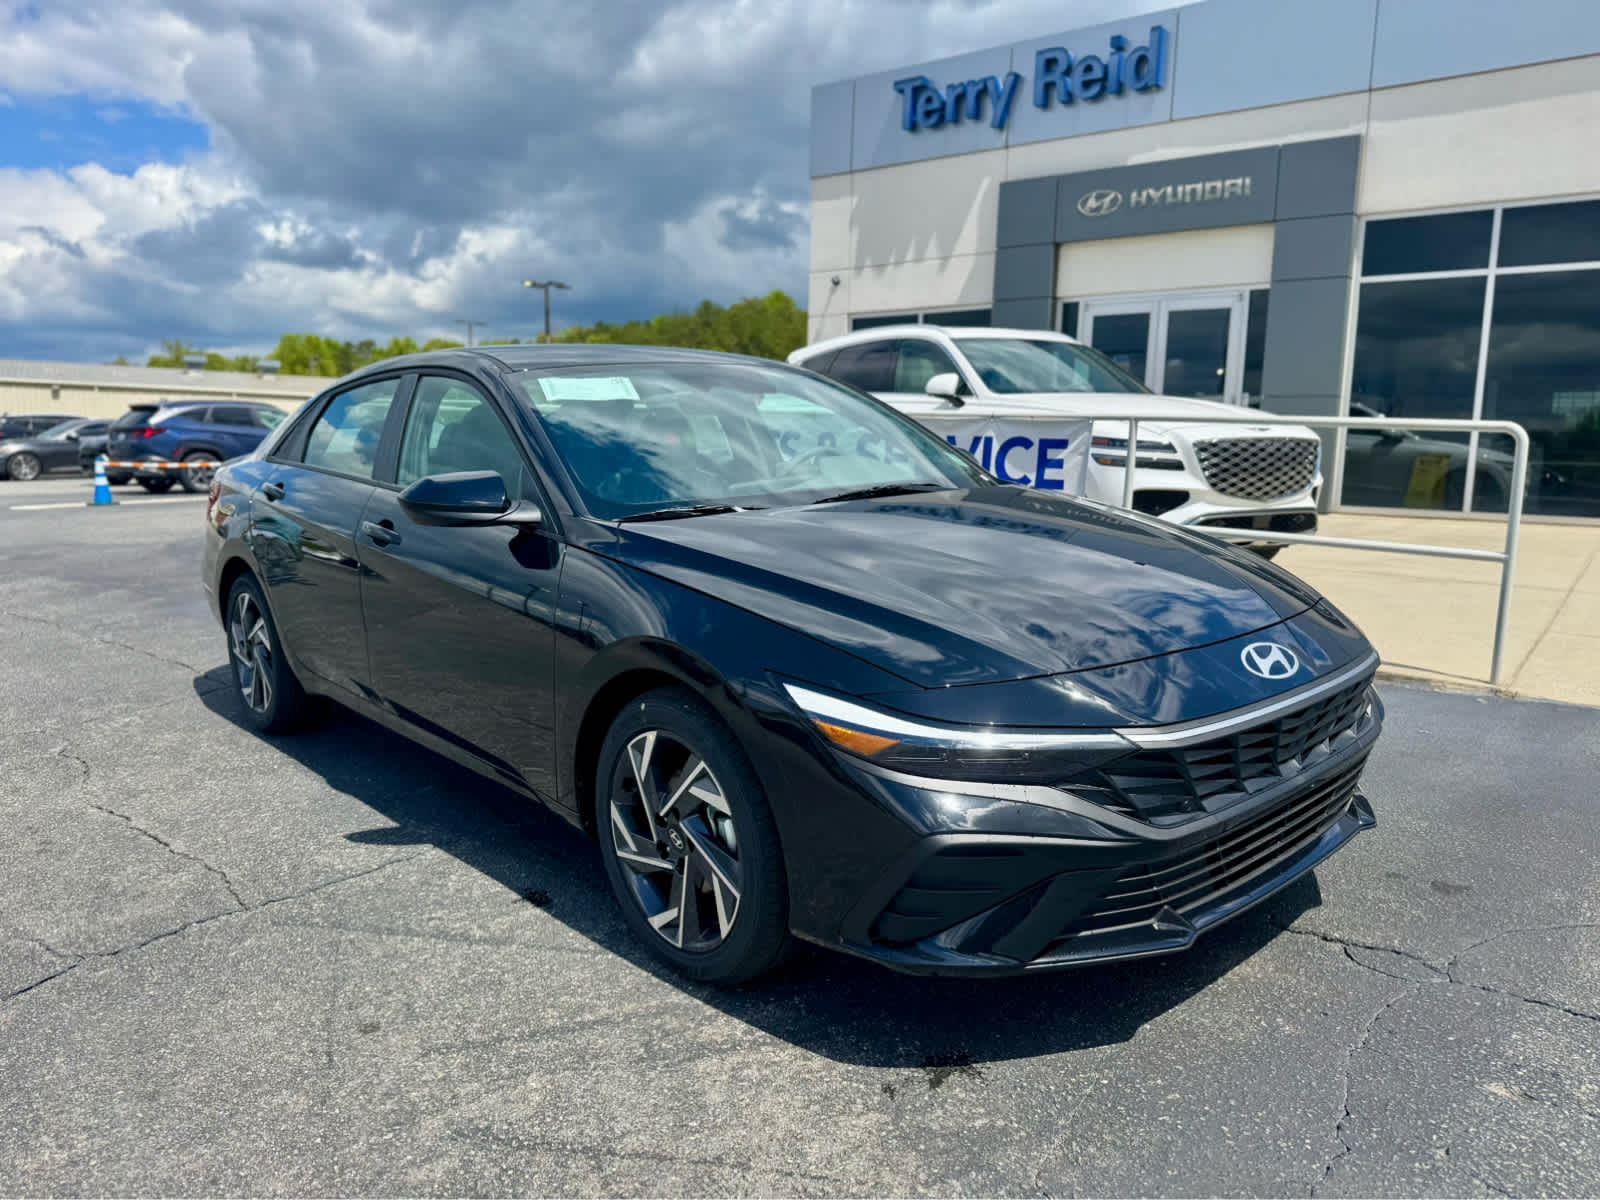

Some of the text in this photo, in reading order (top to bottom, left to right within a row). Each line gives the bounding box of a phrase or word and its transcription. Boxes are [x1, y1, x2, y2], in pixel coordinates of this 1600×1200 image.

[894, 26, 1167, 131] Terry Reid
[1130, 176, 1251, 208] HYUNDAI
